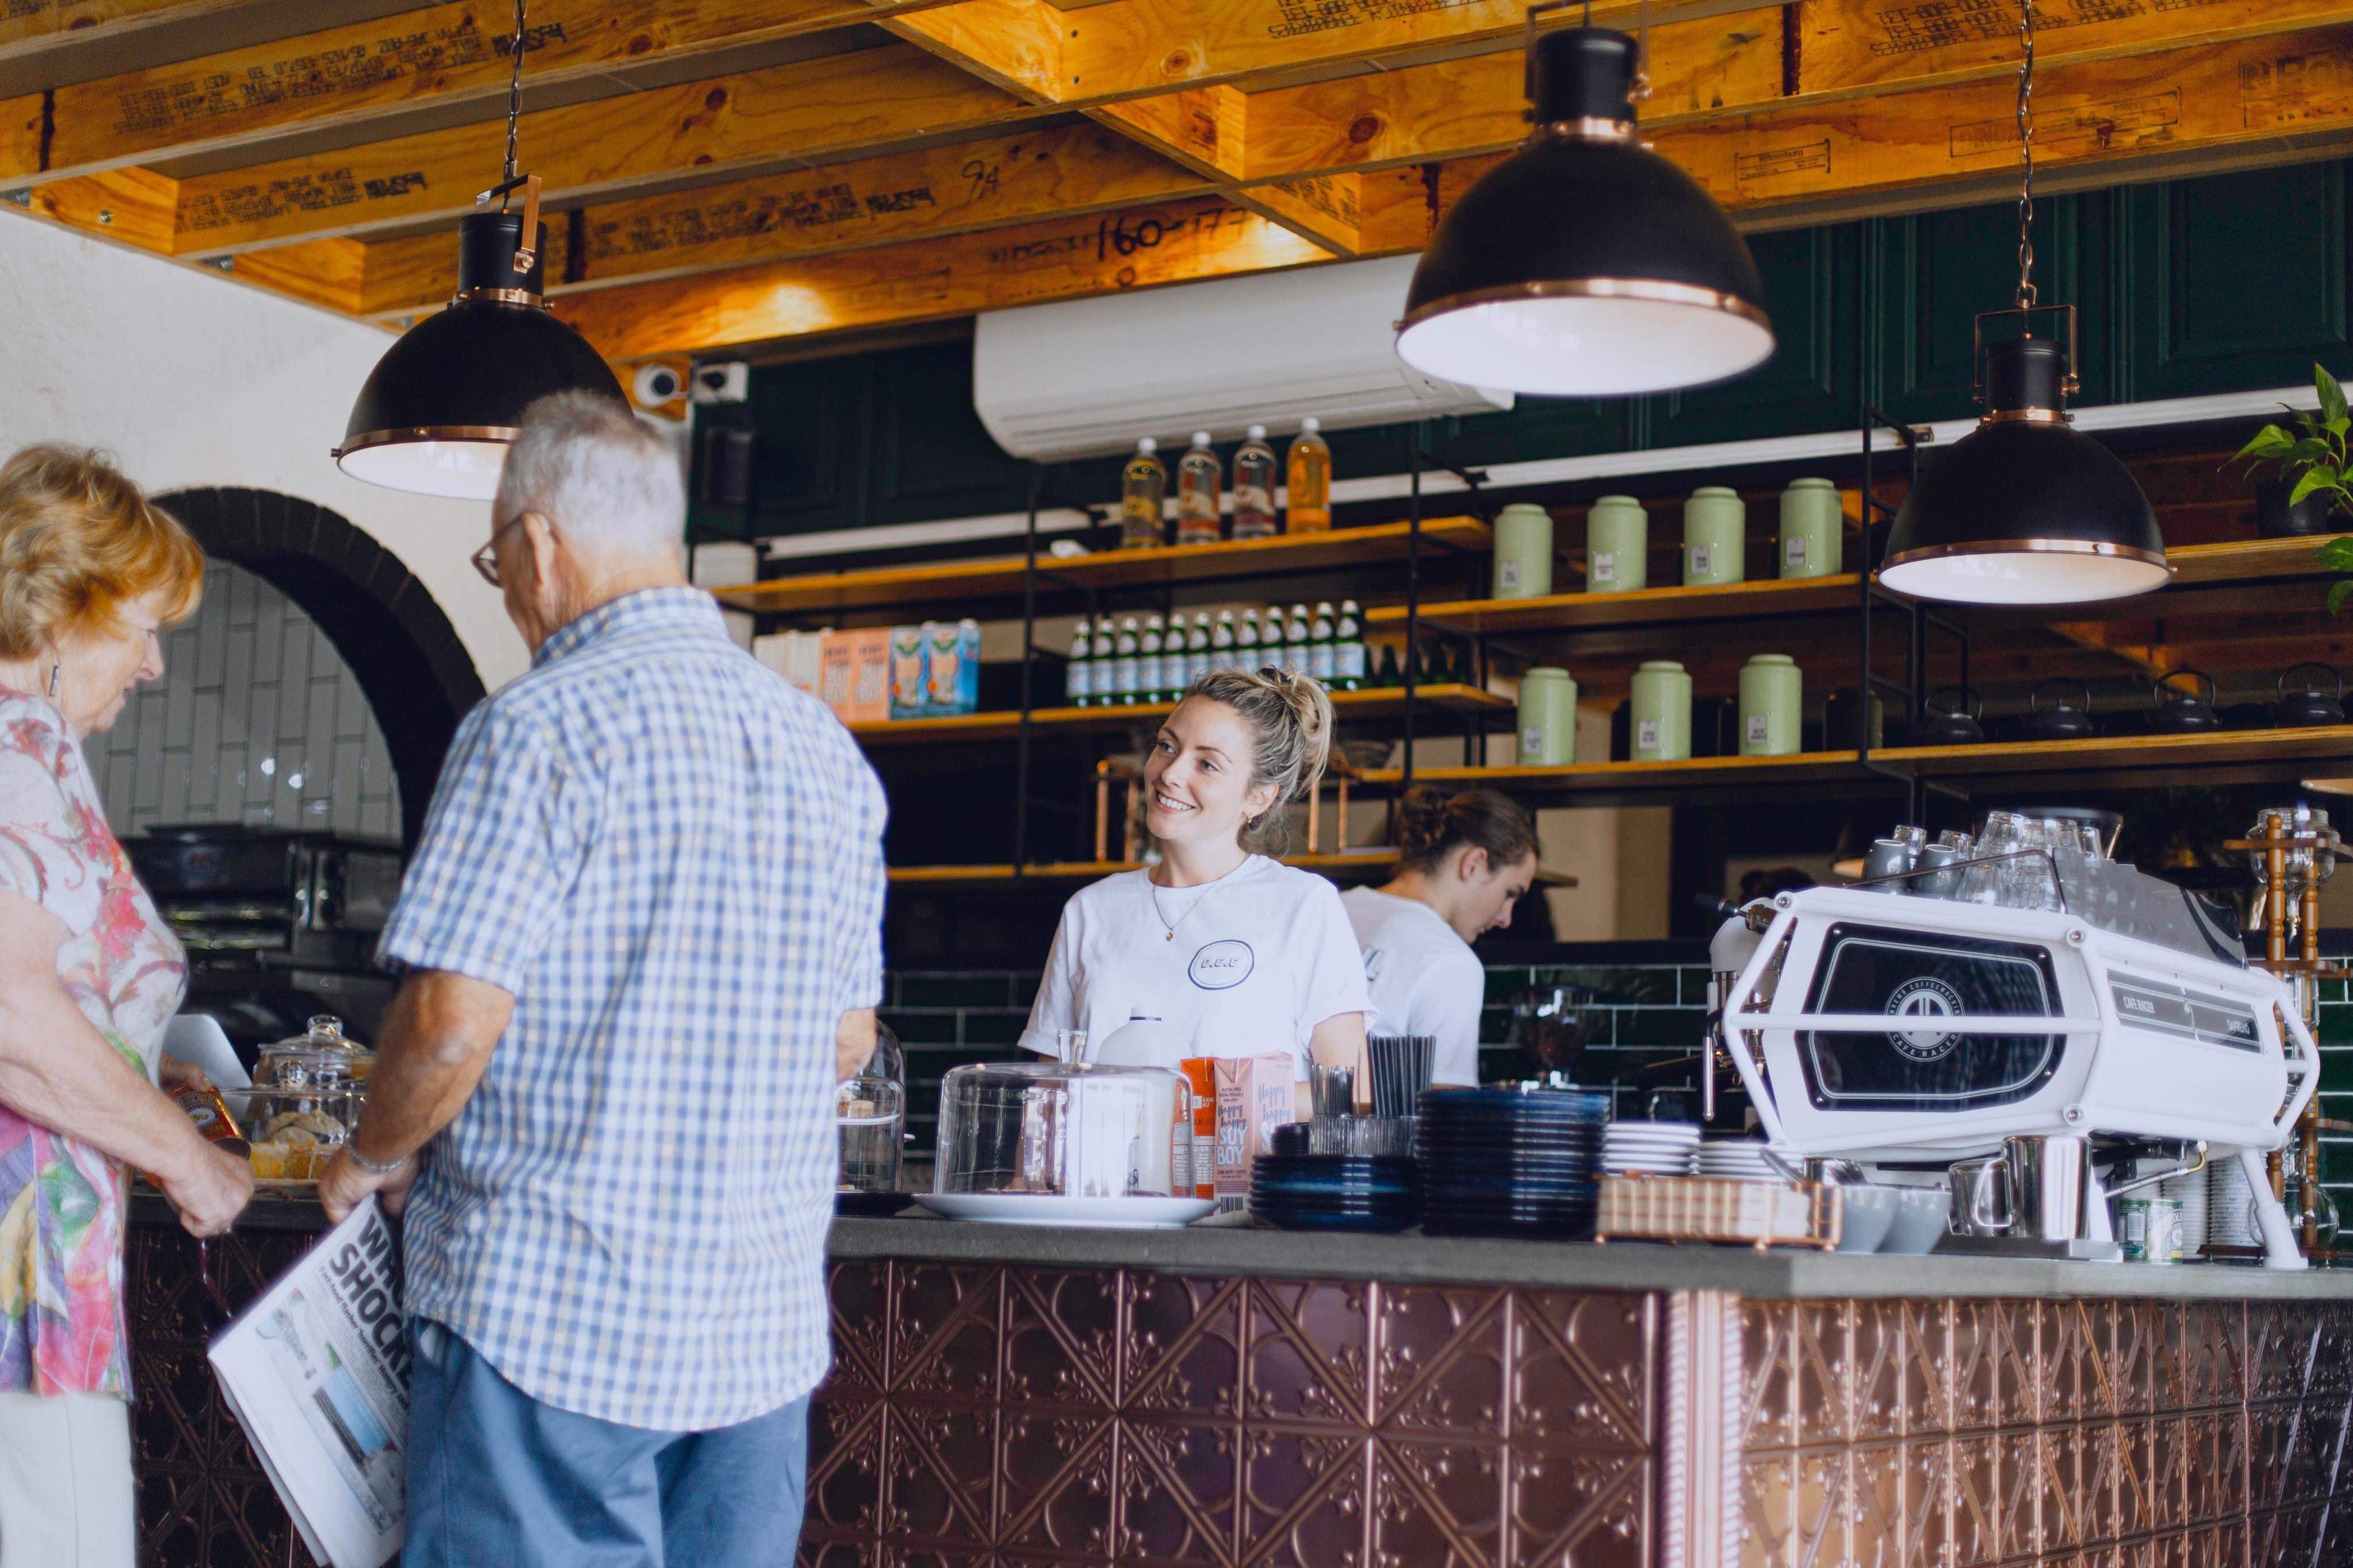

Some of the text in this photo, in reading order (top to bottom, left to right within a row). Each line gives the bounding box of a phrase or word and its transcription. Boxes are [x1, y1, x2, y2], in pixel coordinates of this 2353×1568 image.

[1217, 1104, 1243, 1119] Happy
[1221, 1117, 1246, 1130] happy
[1218, 1126, 1247, 1146] SOY
[1216, 1145, 1245, 1166] BOY
[341, 1302, 359, 1331] flasher
